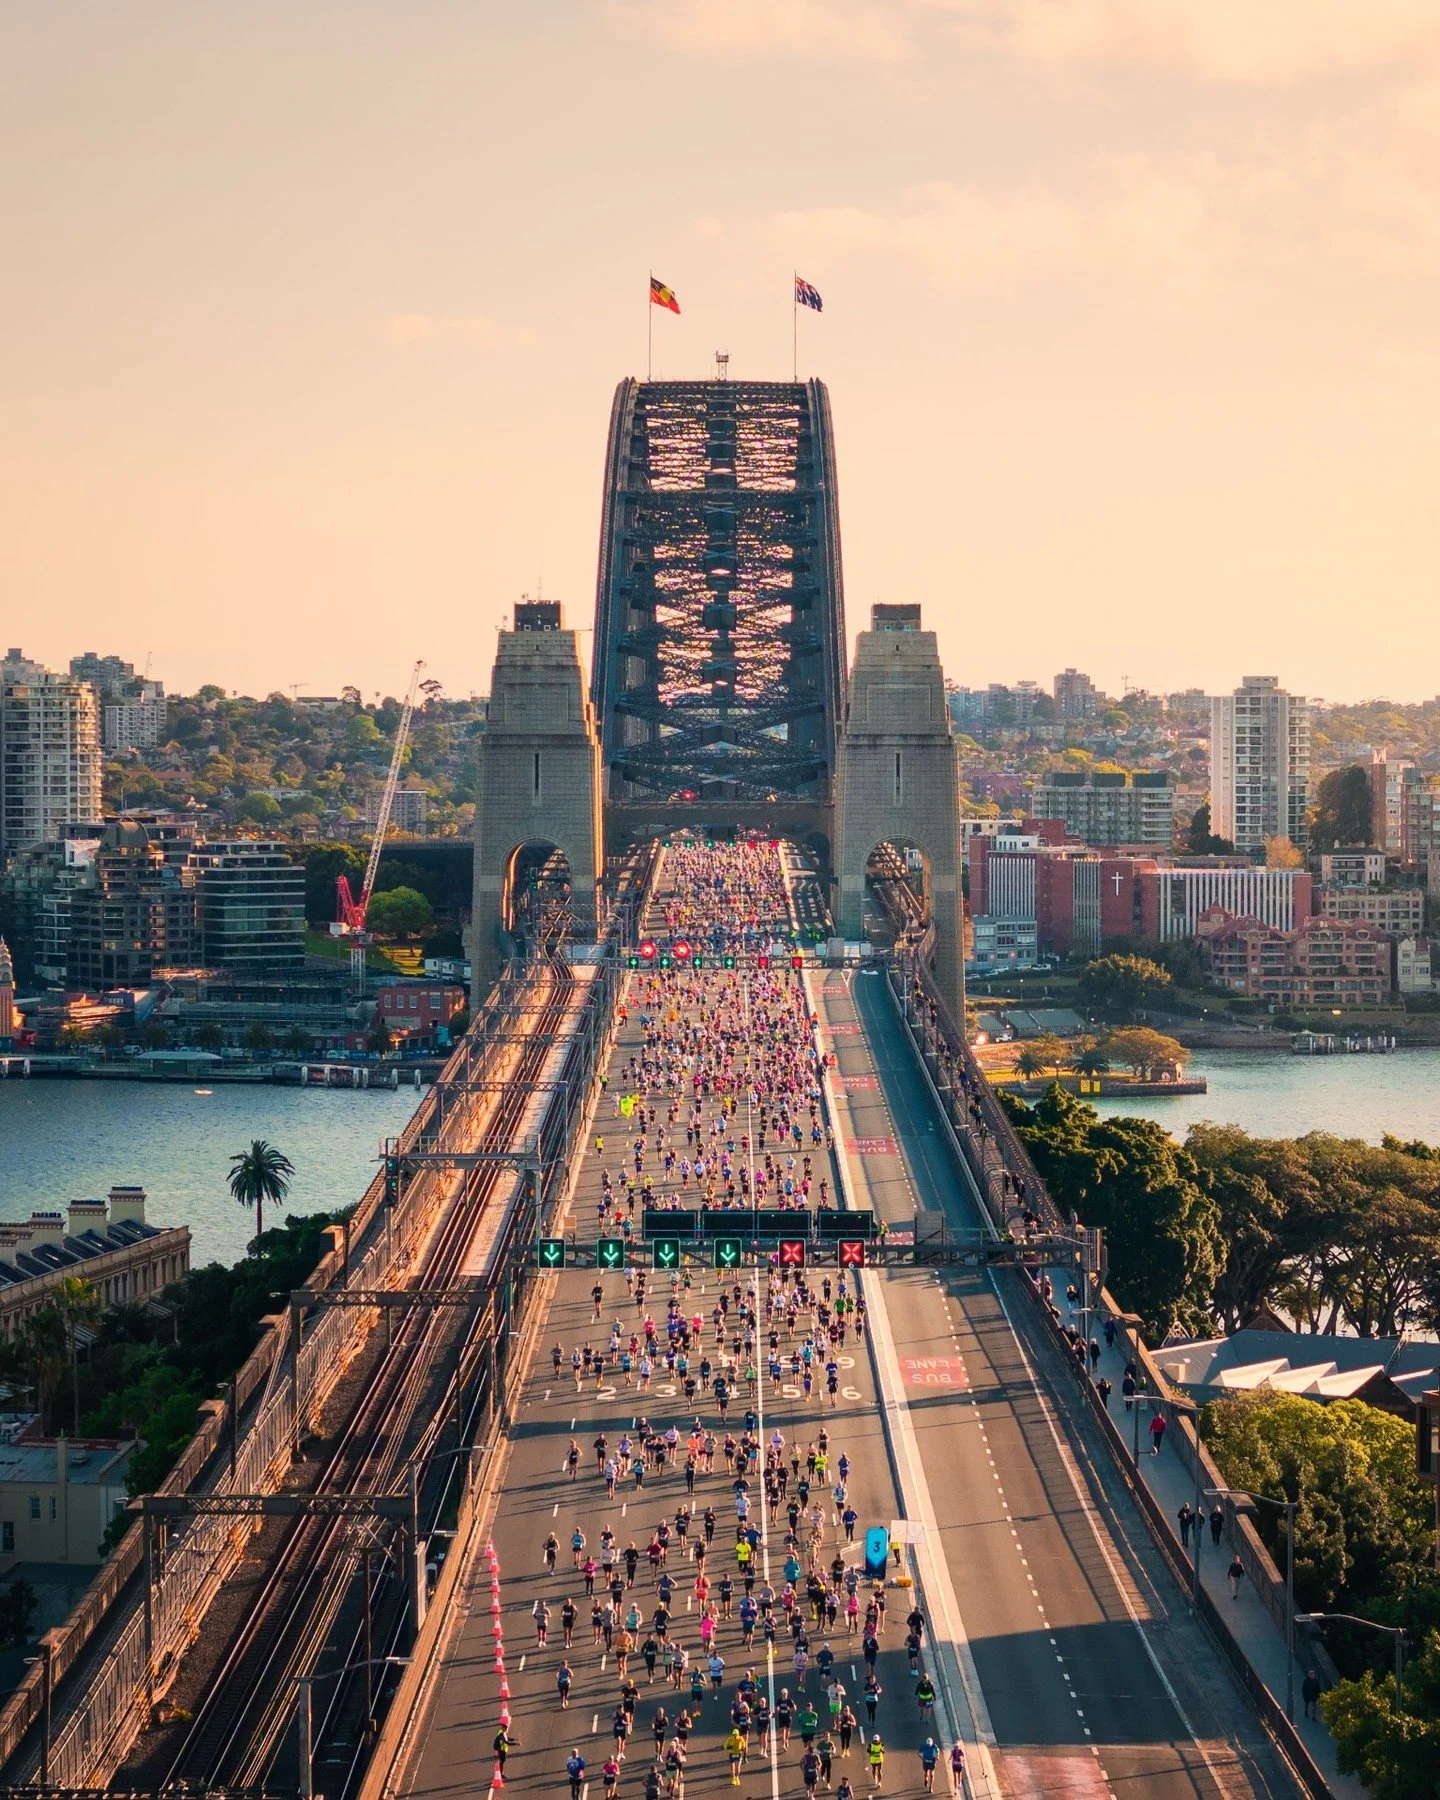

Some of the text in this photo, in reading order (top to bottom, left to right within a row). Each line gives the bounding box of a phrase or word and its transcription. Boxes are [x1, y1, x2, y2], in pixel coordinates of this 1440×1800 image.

[724, 1261, 732, 1269] 4
[848, 1261, 855, 1269] 6
[905, 1360, 951, 1369] LANE
[911, 1373, 952, 1383] BUS
[596, 1385, 617, 1400] 2
[655, 1384, 677, 1398] 3
[782, 1384, 801, 1399] 5
[841, 1385, 862, 1400] 6
[873, 1541, 881, 1553] 3
